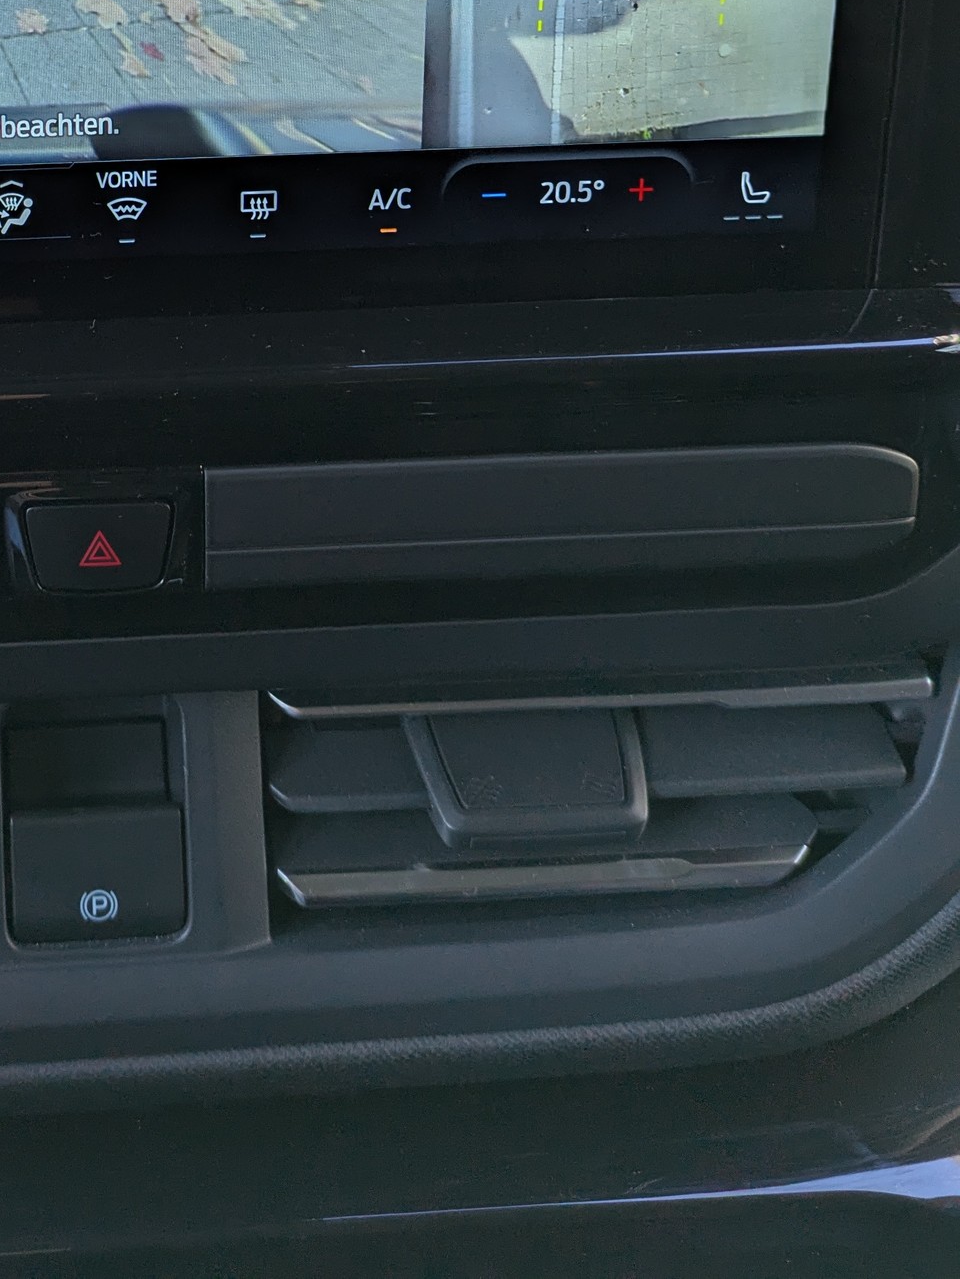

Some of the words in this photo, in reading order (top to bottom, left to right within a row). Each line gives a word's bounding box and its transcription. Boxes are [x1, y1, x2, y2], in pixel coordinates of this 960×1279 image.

[0, 112, 120, 139] beachten.
[96, 170, 158, 188] VORNE
[368, 188, 413, 211] A/C
[539, 179, 605, 205] 20.5°
